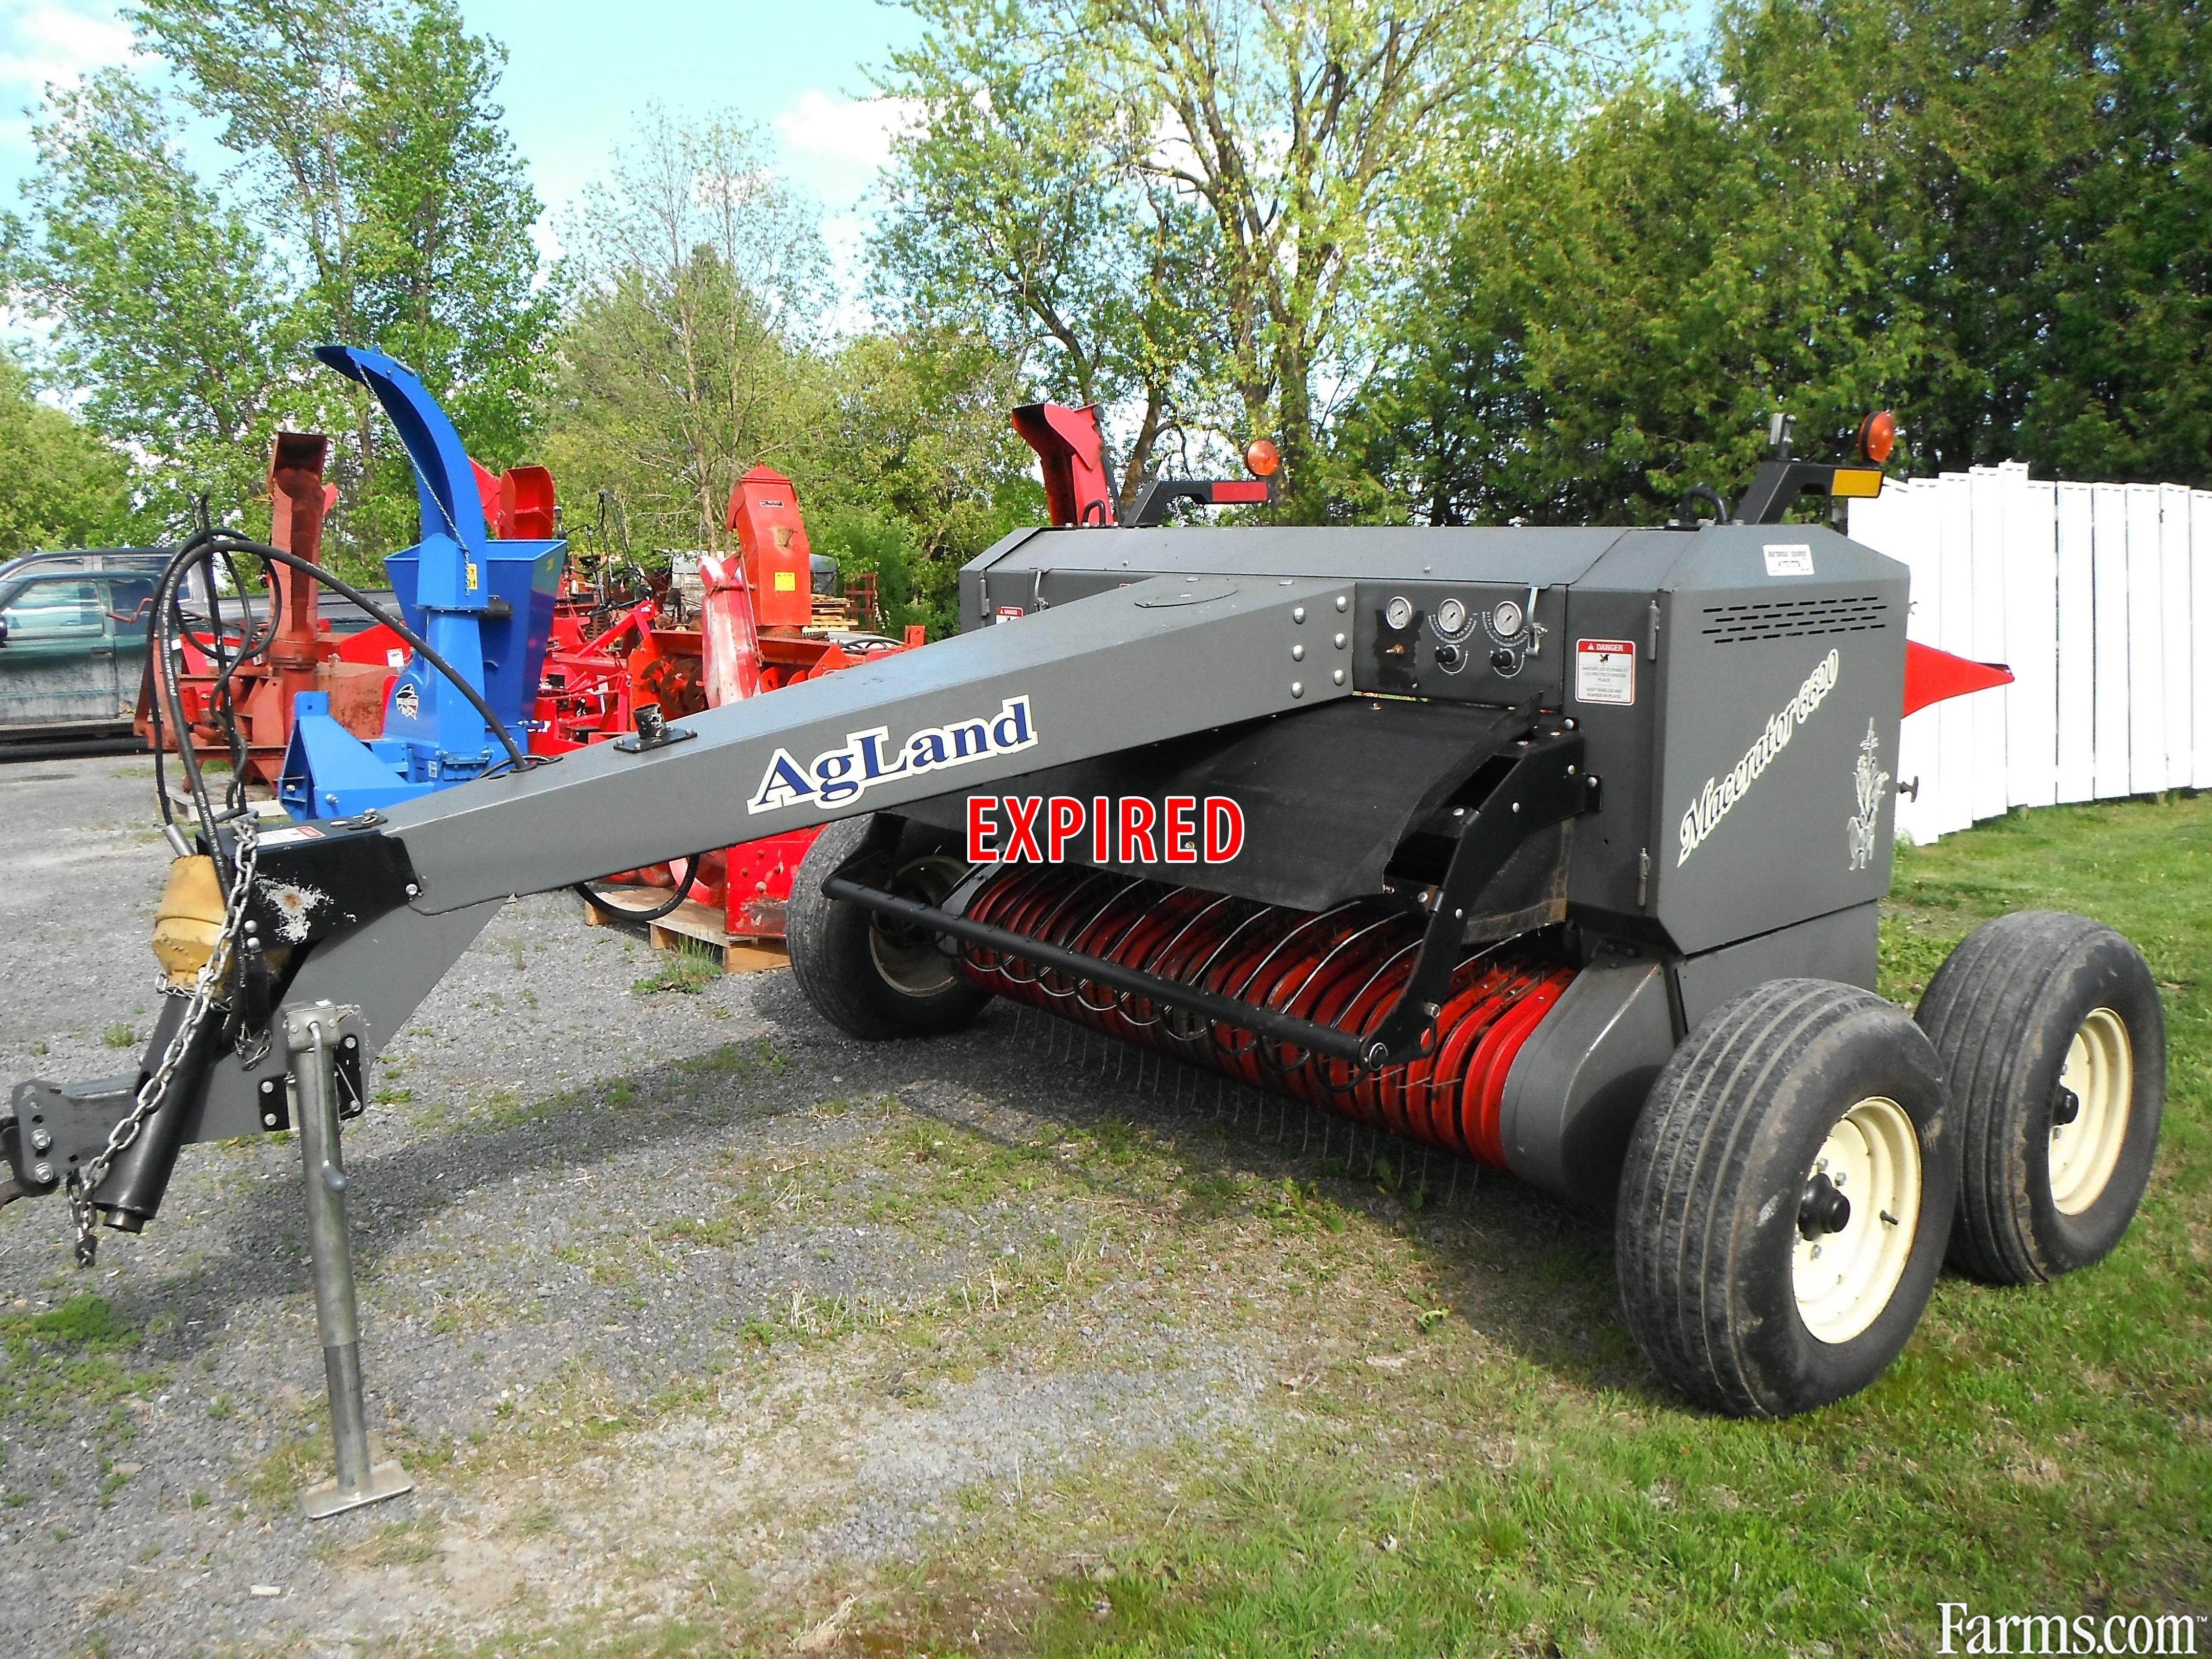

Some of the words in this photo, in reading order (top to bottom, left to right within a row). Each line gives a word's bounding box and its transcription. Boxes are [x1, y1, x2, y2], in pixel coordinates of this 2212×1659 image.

[1596, 643, 1623, 651] DANGER
[749, 696, 1037, 812] AgLand
[1677, 697, 1797, 867] Macerator
